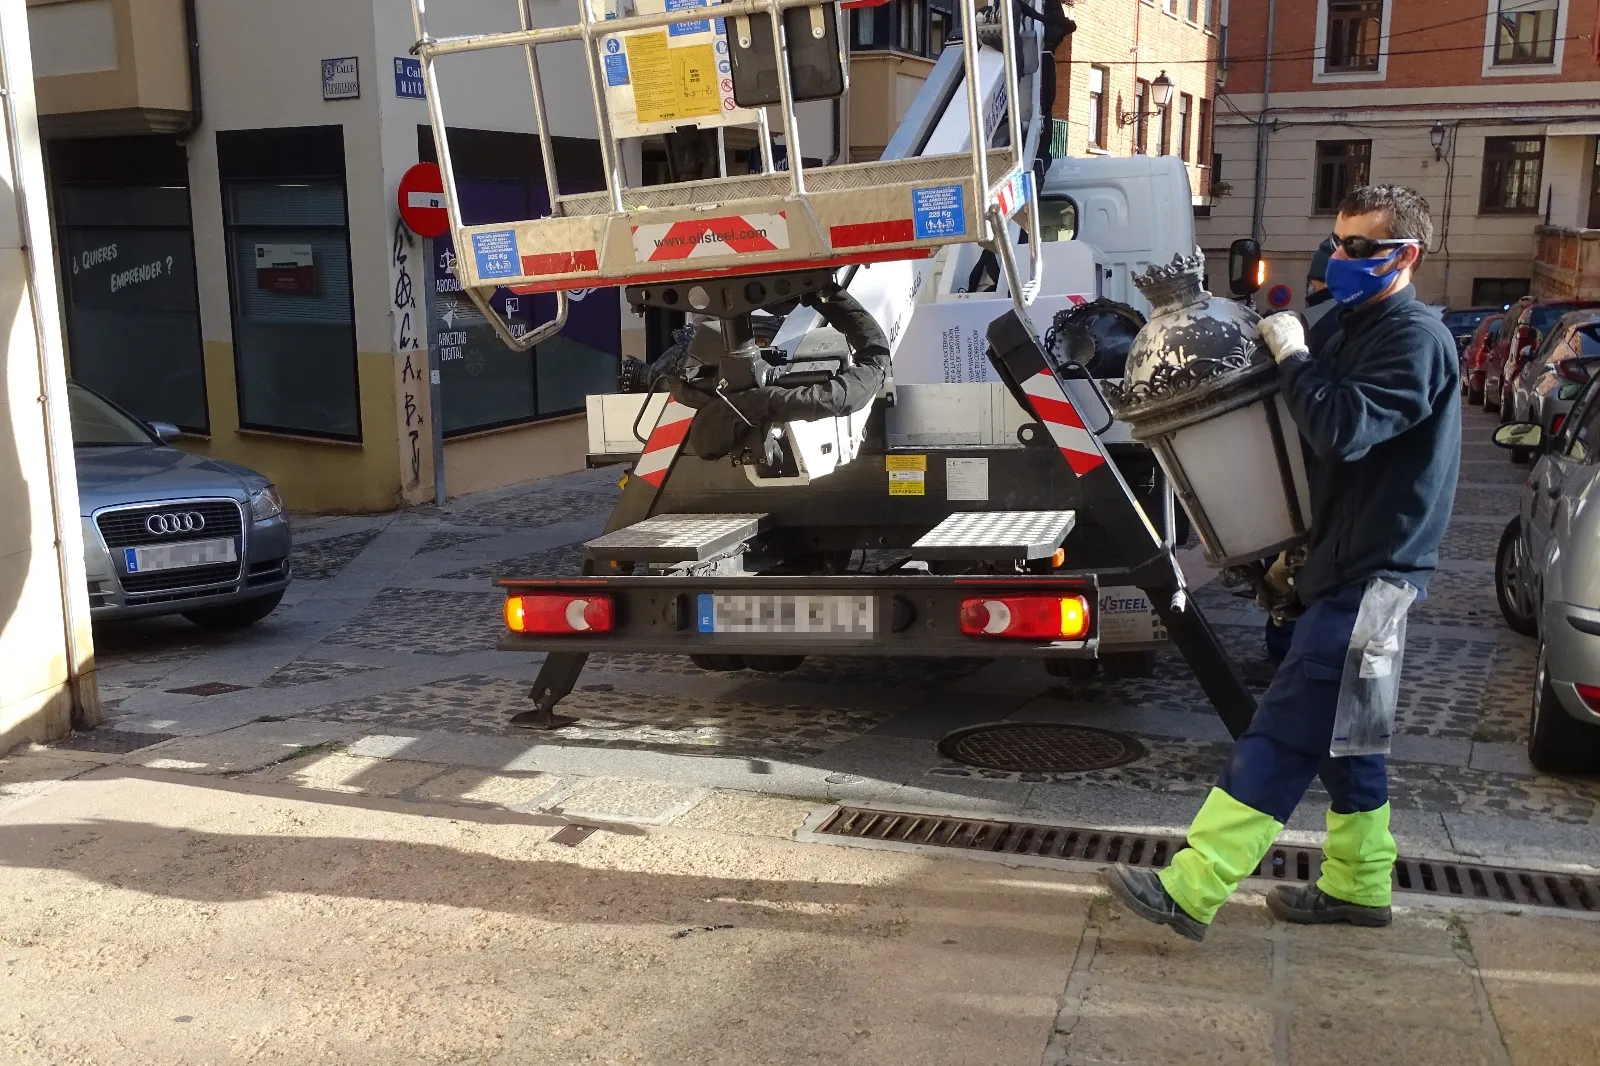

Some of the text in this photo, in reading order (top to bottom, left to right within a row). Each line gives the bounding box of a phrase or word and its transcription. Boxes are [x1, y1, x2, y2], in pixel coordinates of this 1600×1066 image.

[336, 64, 355, 74] CALLE
[406, 66, 423, 78] Cal
[401, 80, 426, 95] MAYO
[654, 227, 767, 249] www.oilsteel.com
[82, 243, 118, 270] QUIERES
[110, 260, 162, 293] EMPRENDER
[437, 331, 467, 347] ARKETING
[441, 346, 464, 361] DIGITAL
[702, 616, 710, 625] E
